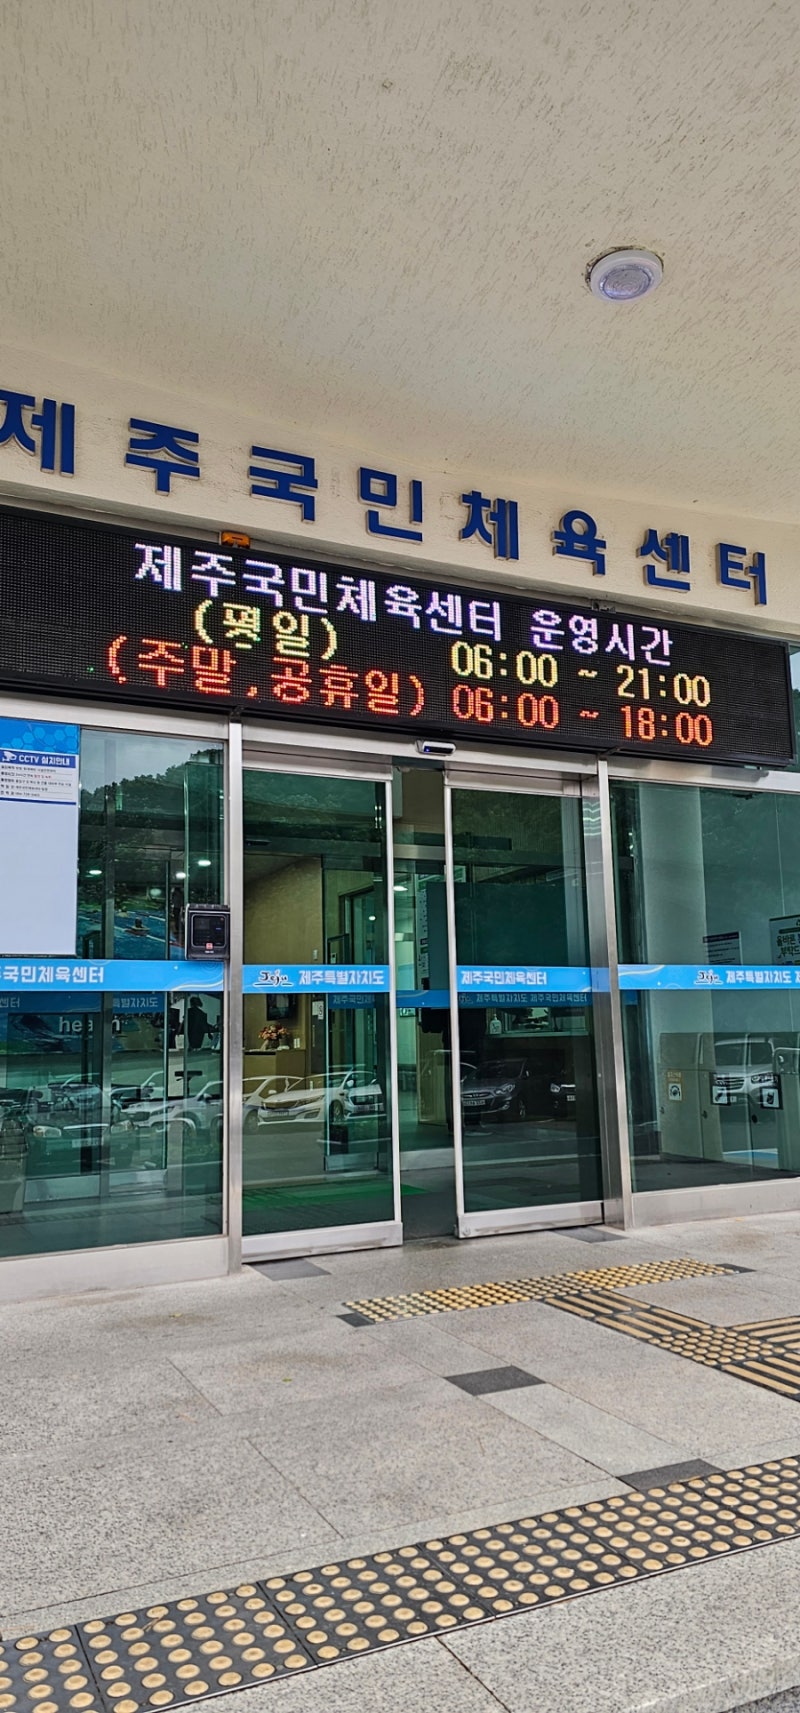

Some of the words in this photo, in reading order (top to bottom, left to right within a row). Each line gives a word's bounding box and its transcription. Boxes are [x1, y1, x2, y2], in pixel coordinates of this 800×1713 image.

[0, 389, 767, 605] 제주국민체육센터
[134, 543, 501, 641] 제주국민체육센터
[530, 609, 673, 667] 운영시간
[451, 641, 558, 687] 06:00
[616, 664, 711, 707] 21:00
[452, 684, 559, 729] 06:00
[621, 705, 713, 747] 18:00
[18, 754, 39, 764] CCTV
[41, 756, 70, 766] 설치안내
[0, 965, 104, 983] 국민체육센터
[298, 970, 385, 985] 제주특별자치도
[461, 970, 547, 985] 제주국민체육센터
[726, 970, 792, 984] 제주특별자치도
